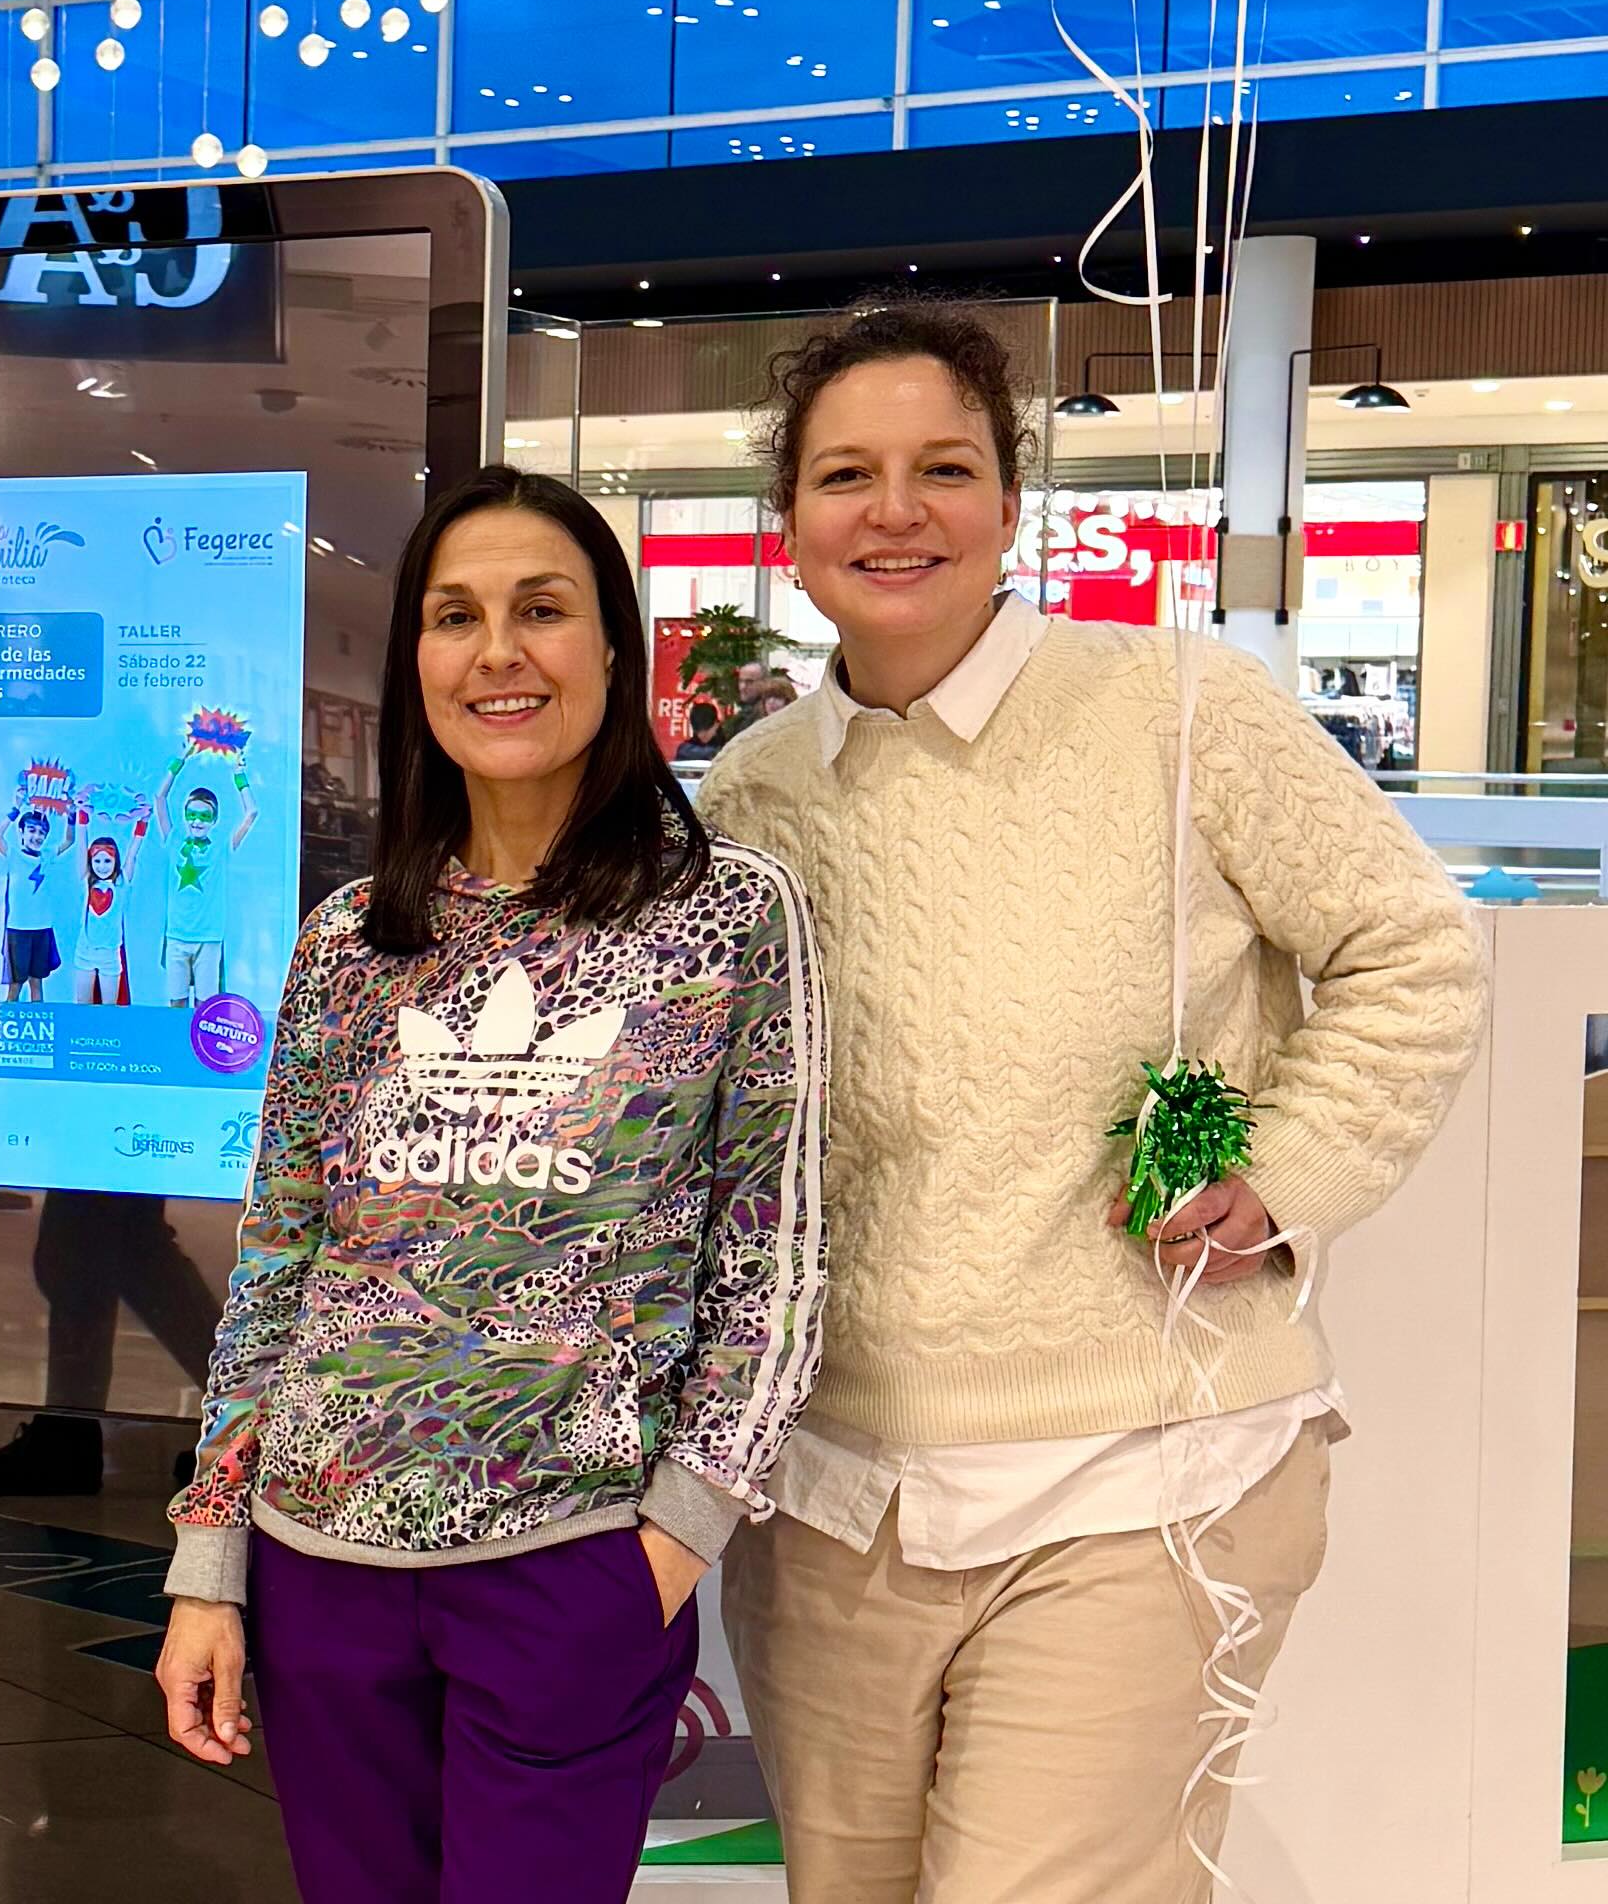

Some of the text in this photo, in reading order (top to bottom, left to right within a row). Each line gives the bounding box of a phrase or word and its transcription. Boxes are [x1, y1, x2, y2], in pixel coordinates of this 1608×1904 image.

[184, 527, 273, 560] Fegerec
[118, 625, 181, 638] TALLER
[1, 646, 23, 663] de
[27, 648, 52, 663] las
[118, 653, 207, 669] Sábado 22
[118, 673, 204, 688] de febrero
[198, 1019, 259, 1046] GRATUITO
[369, 1124, 593, 1195] adidas
